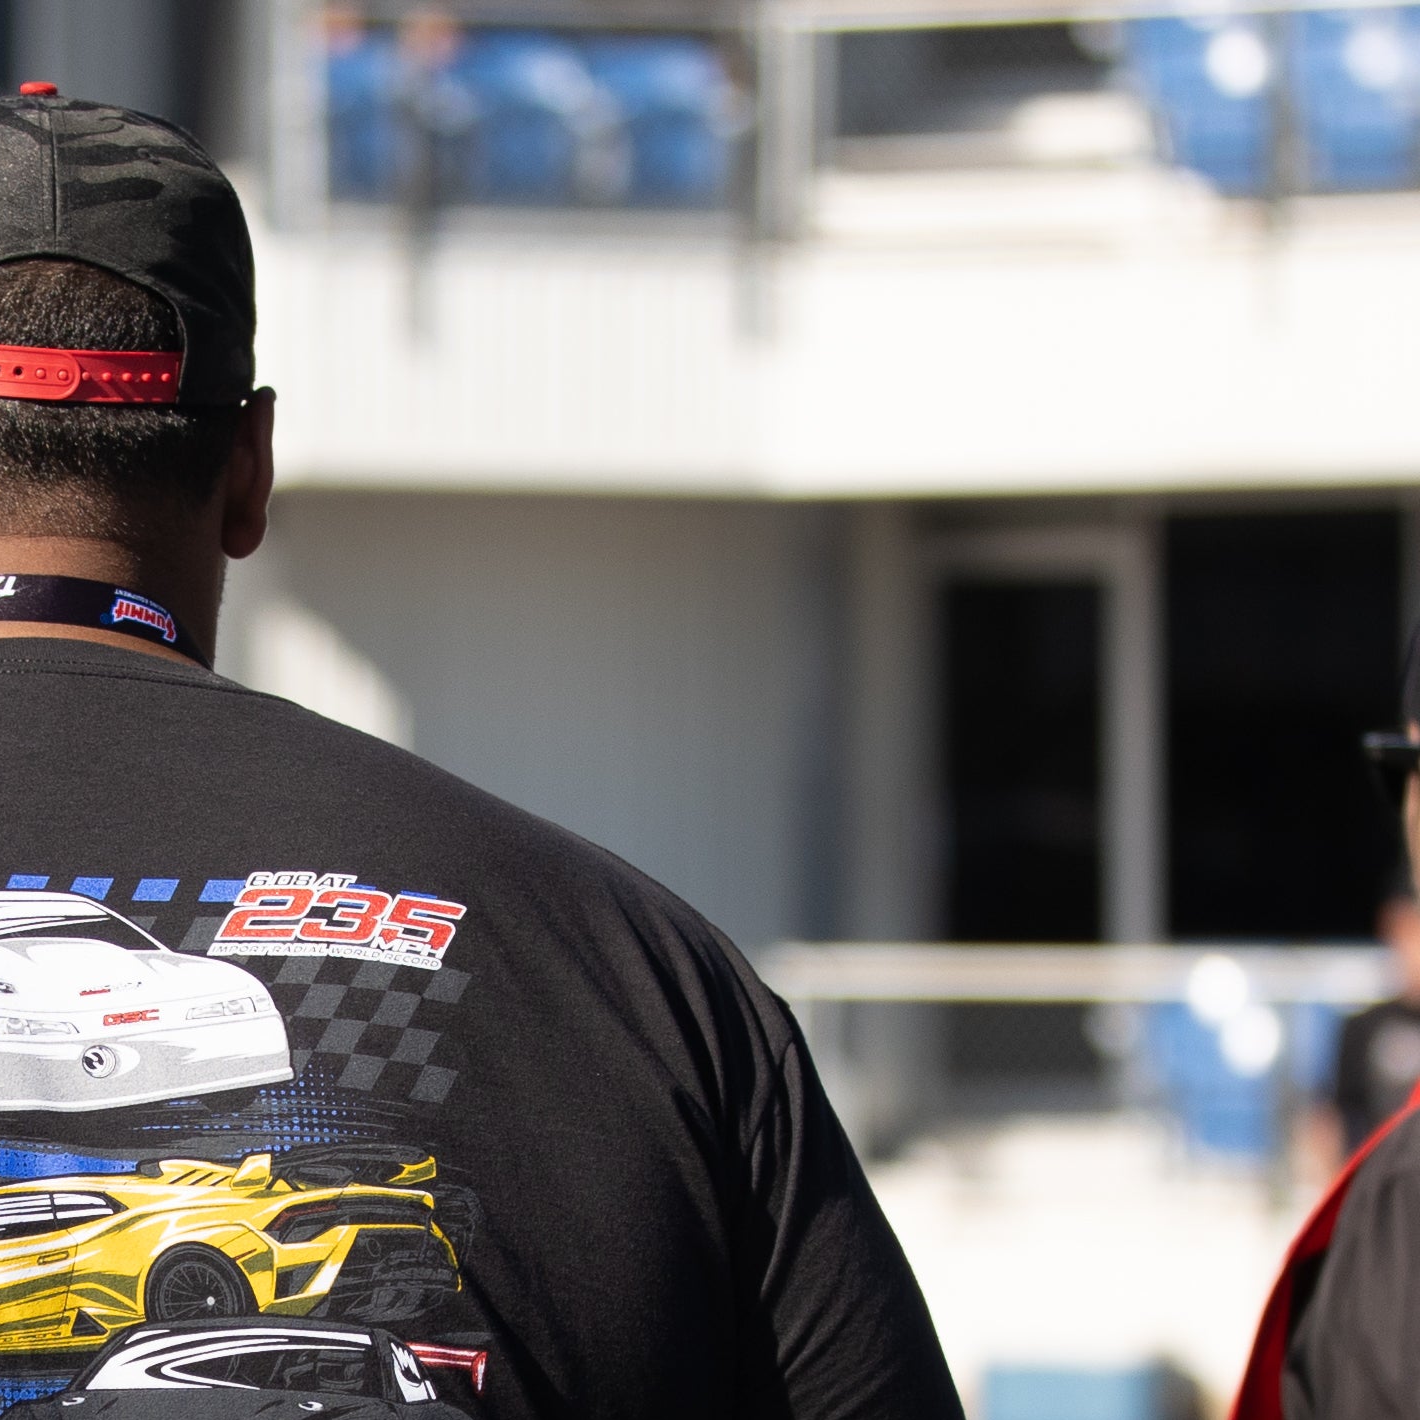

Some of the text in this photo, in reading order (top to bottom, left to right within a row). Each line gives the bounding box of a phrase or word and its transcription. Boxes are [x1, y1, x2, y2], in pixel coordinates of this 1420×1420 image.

[318, 875, 356, 889] AT
[215, 888, 467, 945] 235
[211, 941, 441, 969] IMPORT RADIAL WORLD RECORD
[370, 936, 445, 959] MPH
